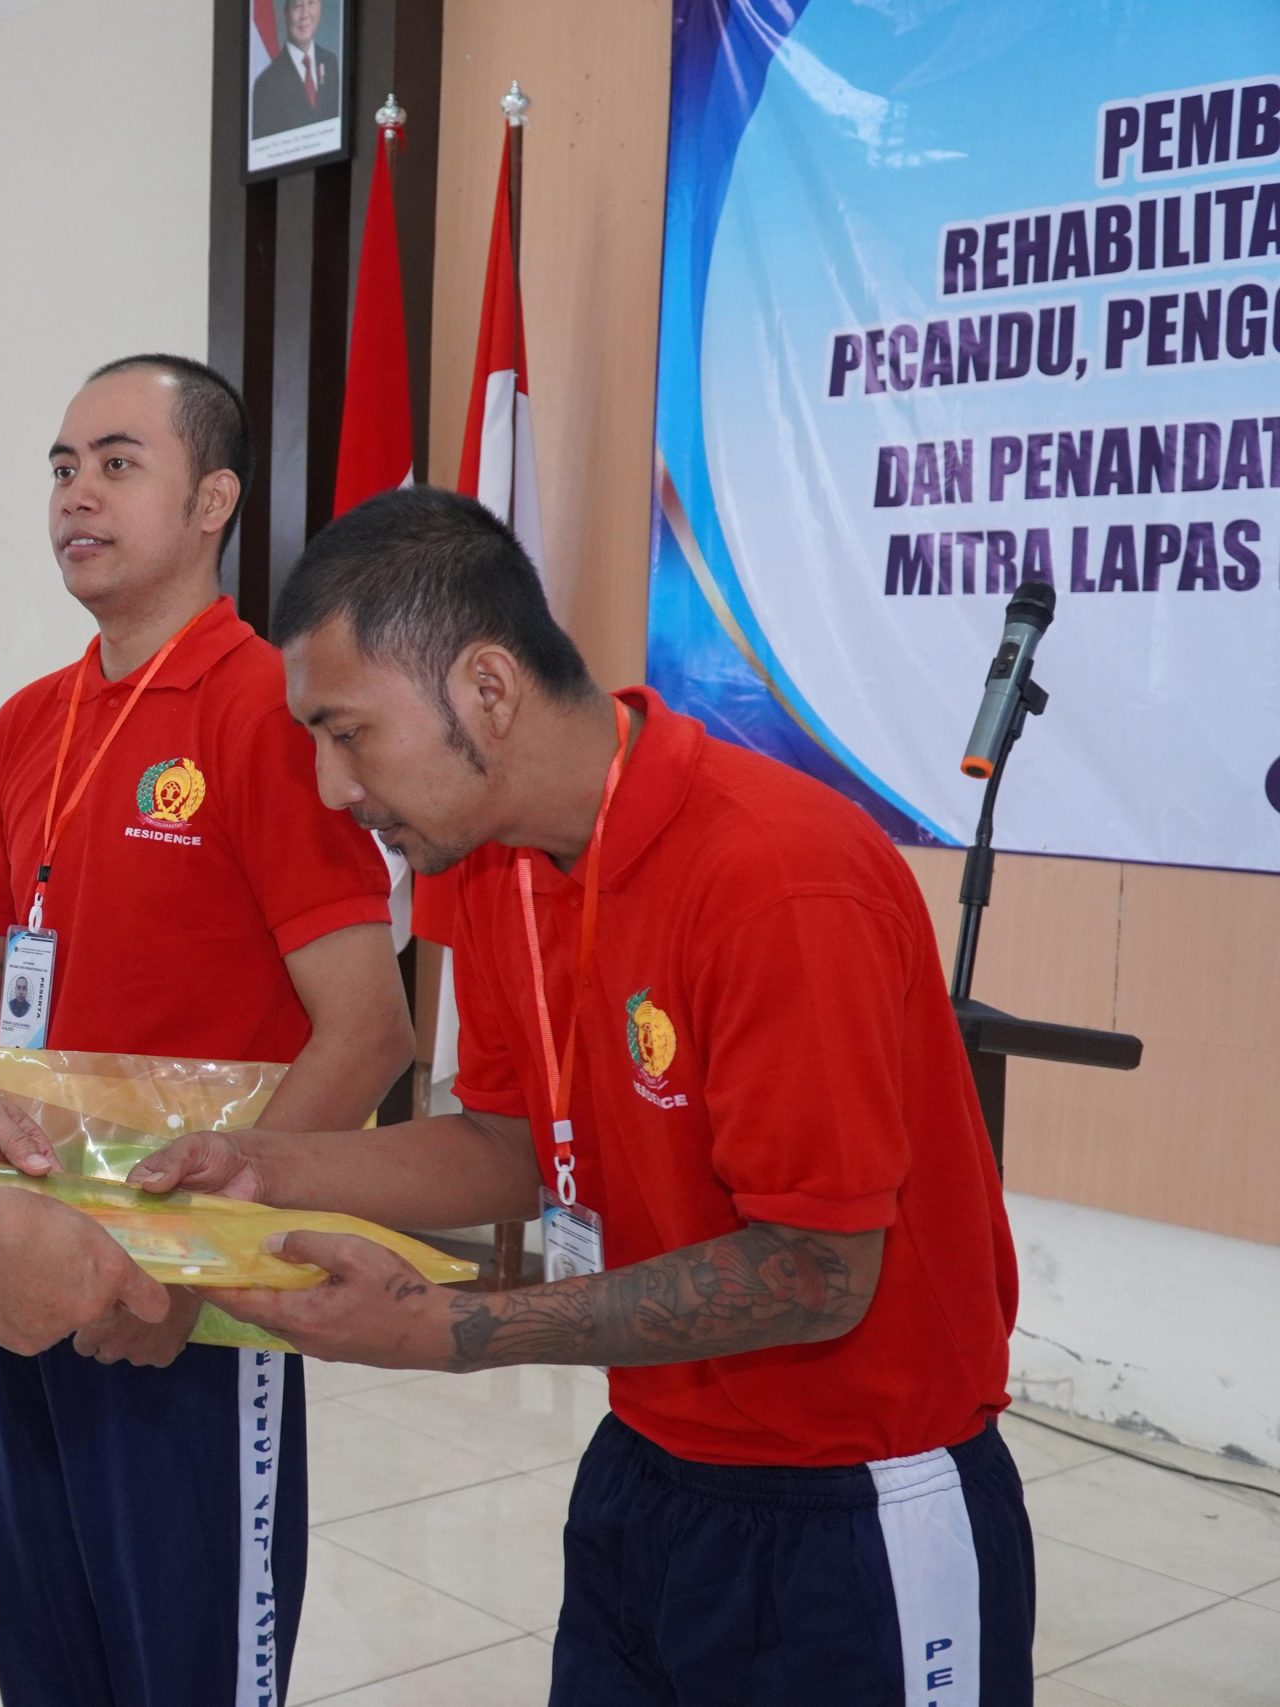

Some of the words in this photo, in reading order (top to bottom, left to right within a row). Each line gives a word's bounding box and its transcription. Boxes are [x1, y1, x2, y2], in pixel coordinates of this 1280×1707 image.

[1102, 83, 1280, 180] PEMB
[942, 183, 1280, 295] REHABILITA
[827, 304, 1088, 397] PECANDU,
[1105, 283, 1280, 370] PENG
[873, 438, 974, 508] DAN
[884, 527, 1056, 596] MITRA
[1071, 519, 1262, 593] LAPAS
[125, 827, 202, 846] RESIDENCE
